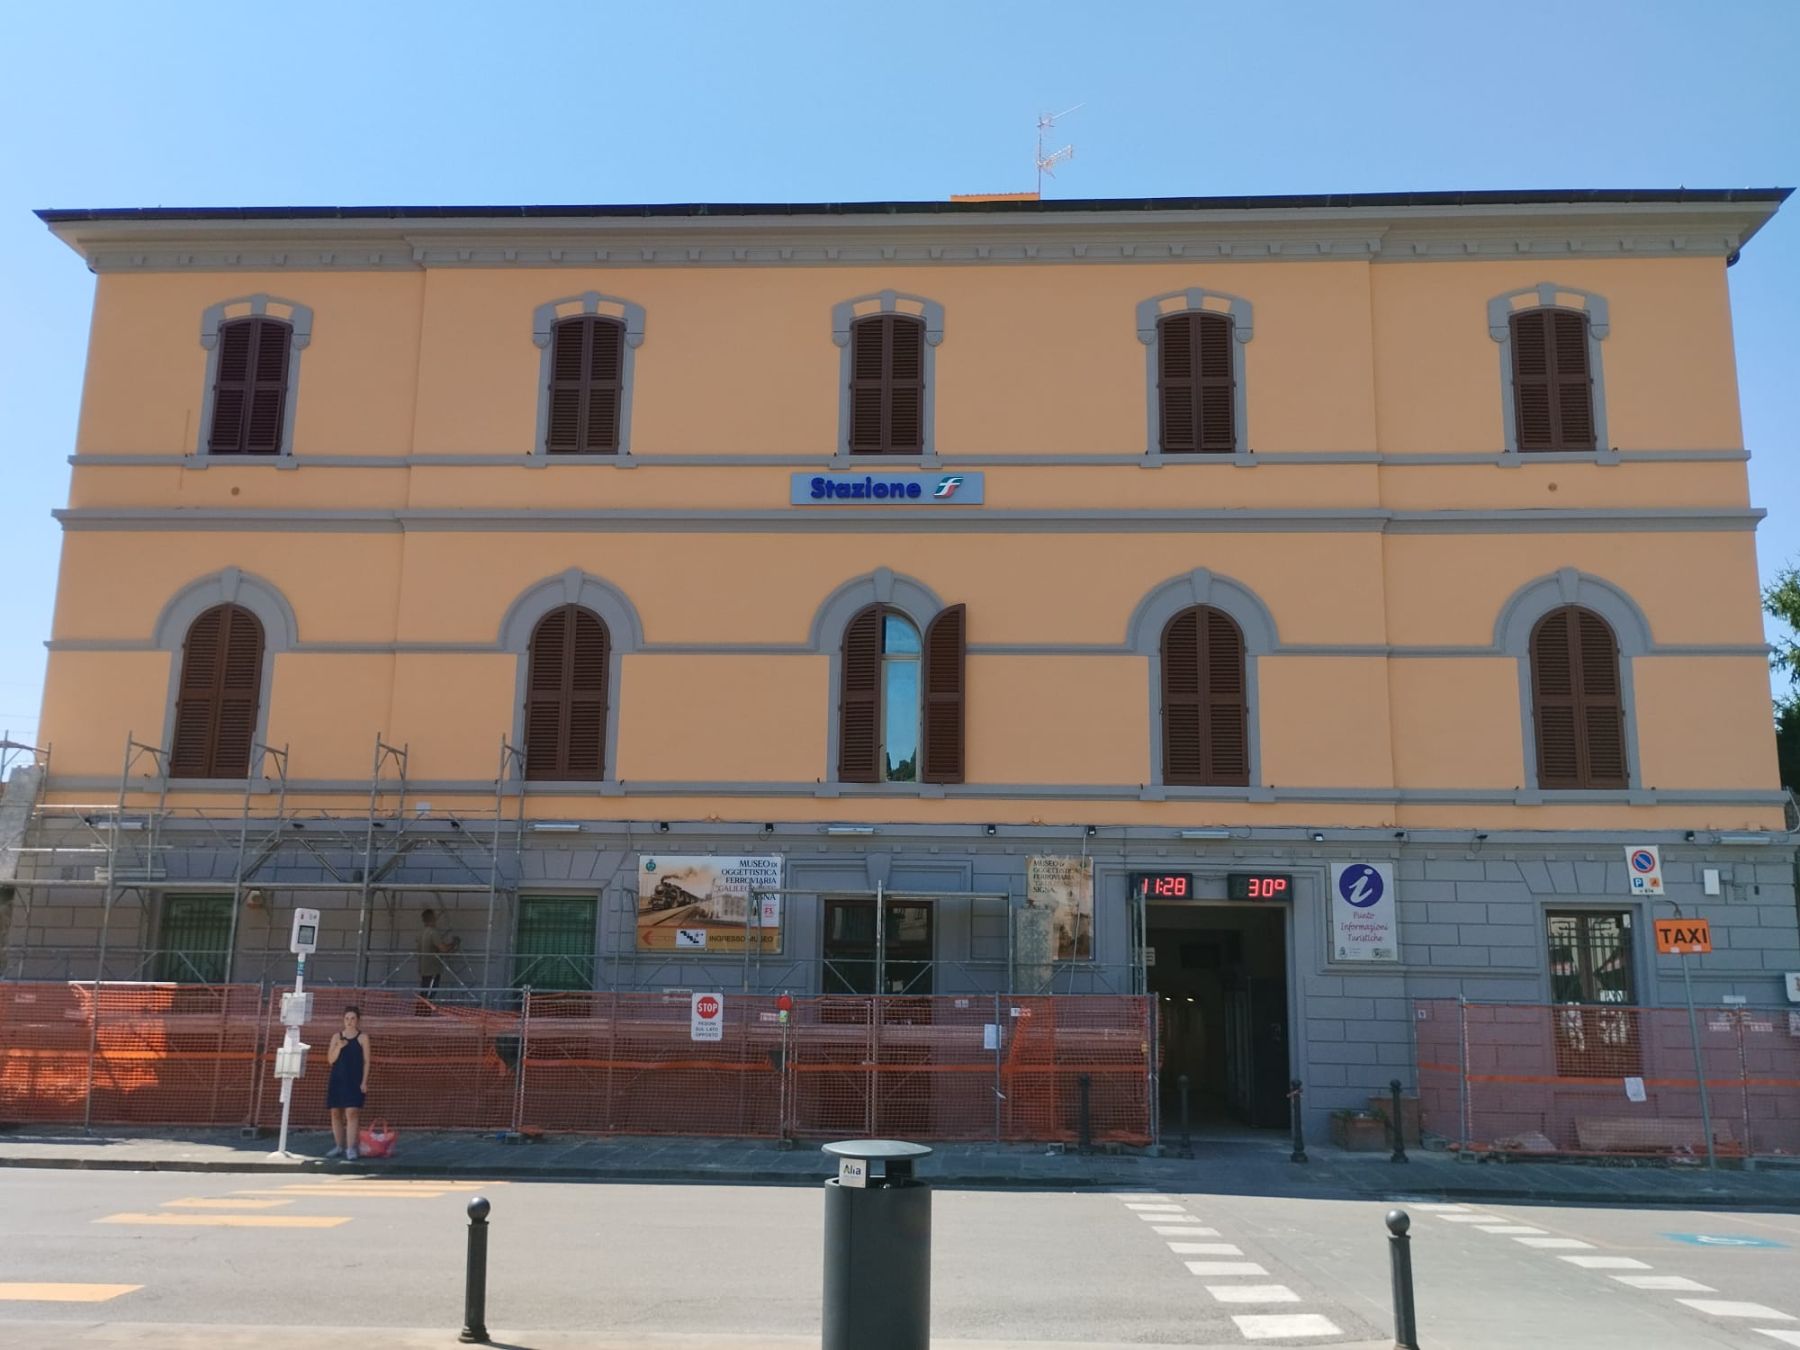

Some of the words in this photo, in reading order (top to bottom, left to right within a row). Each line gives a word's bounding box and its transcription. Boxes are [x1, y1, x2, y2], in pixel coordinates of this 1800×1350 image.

[811, 476, 922, 498] Stazione
[740, 860, 770, 868] MUSEO
[1142, 877, 1186, 896] 11:28
[1659, 928, 1708, 944] TAXI
[698, 1003, 718, 1012] STOP
[843, 1164, 862, 1175] Alia
